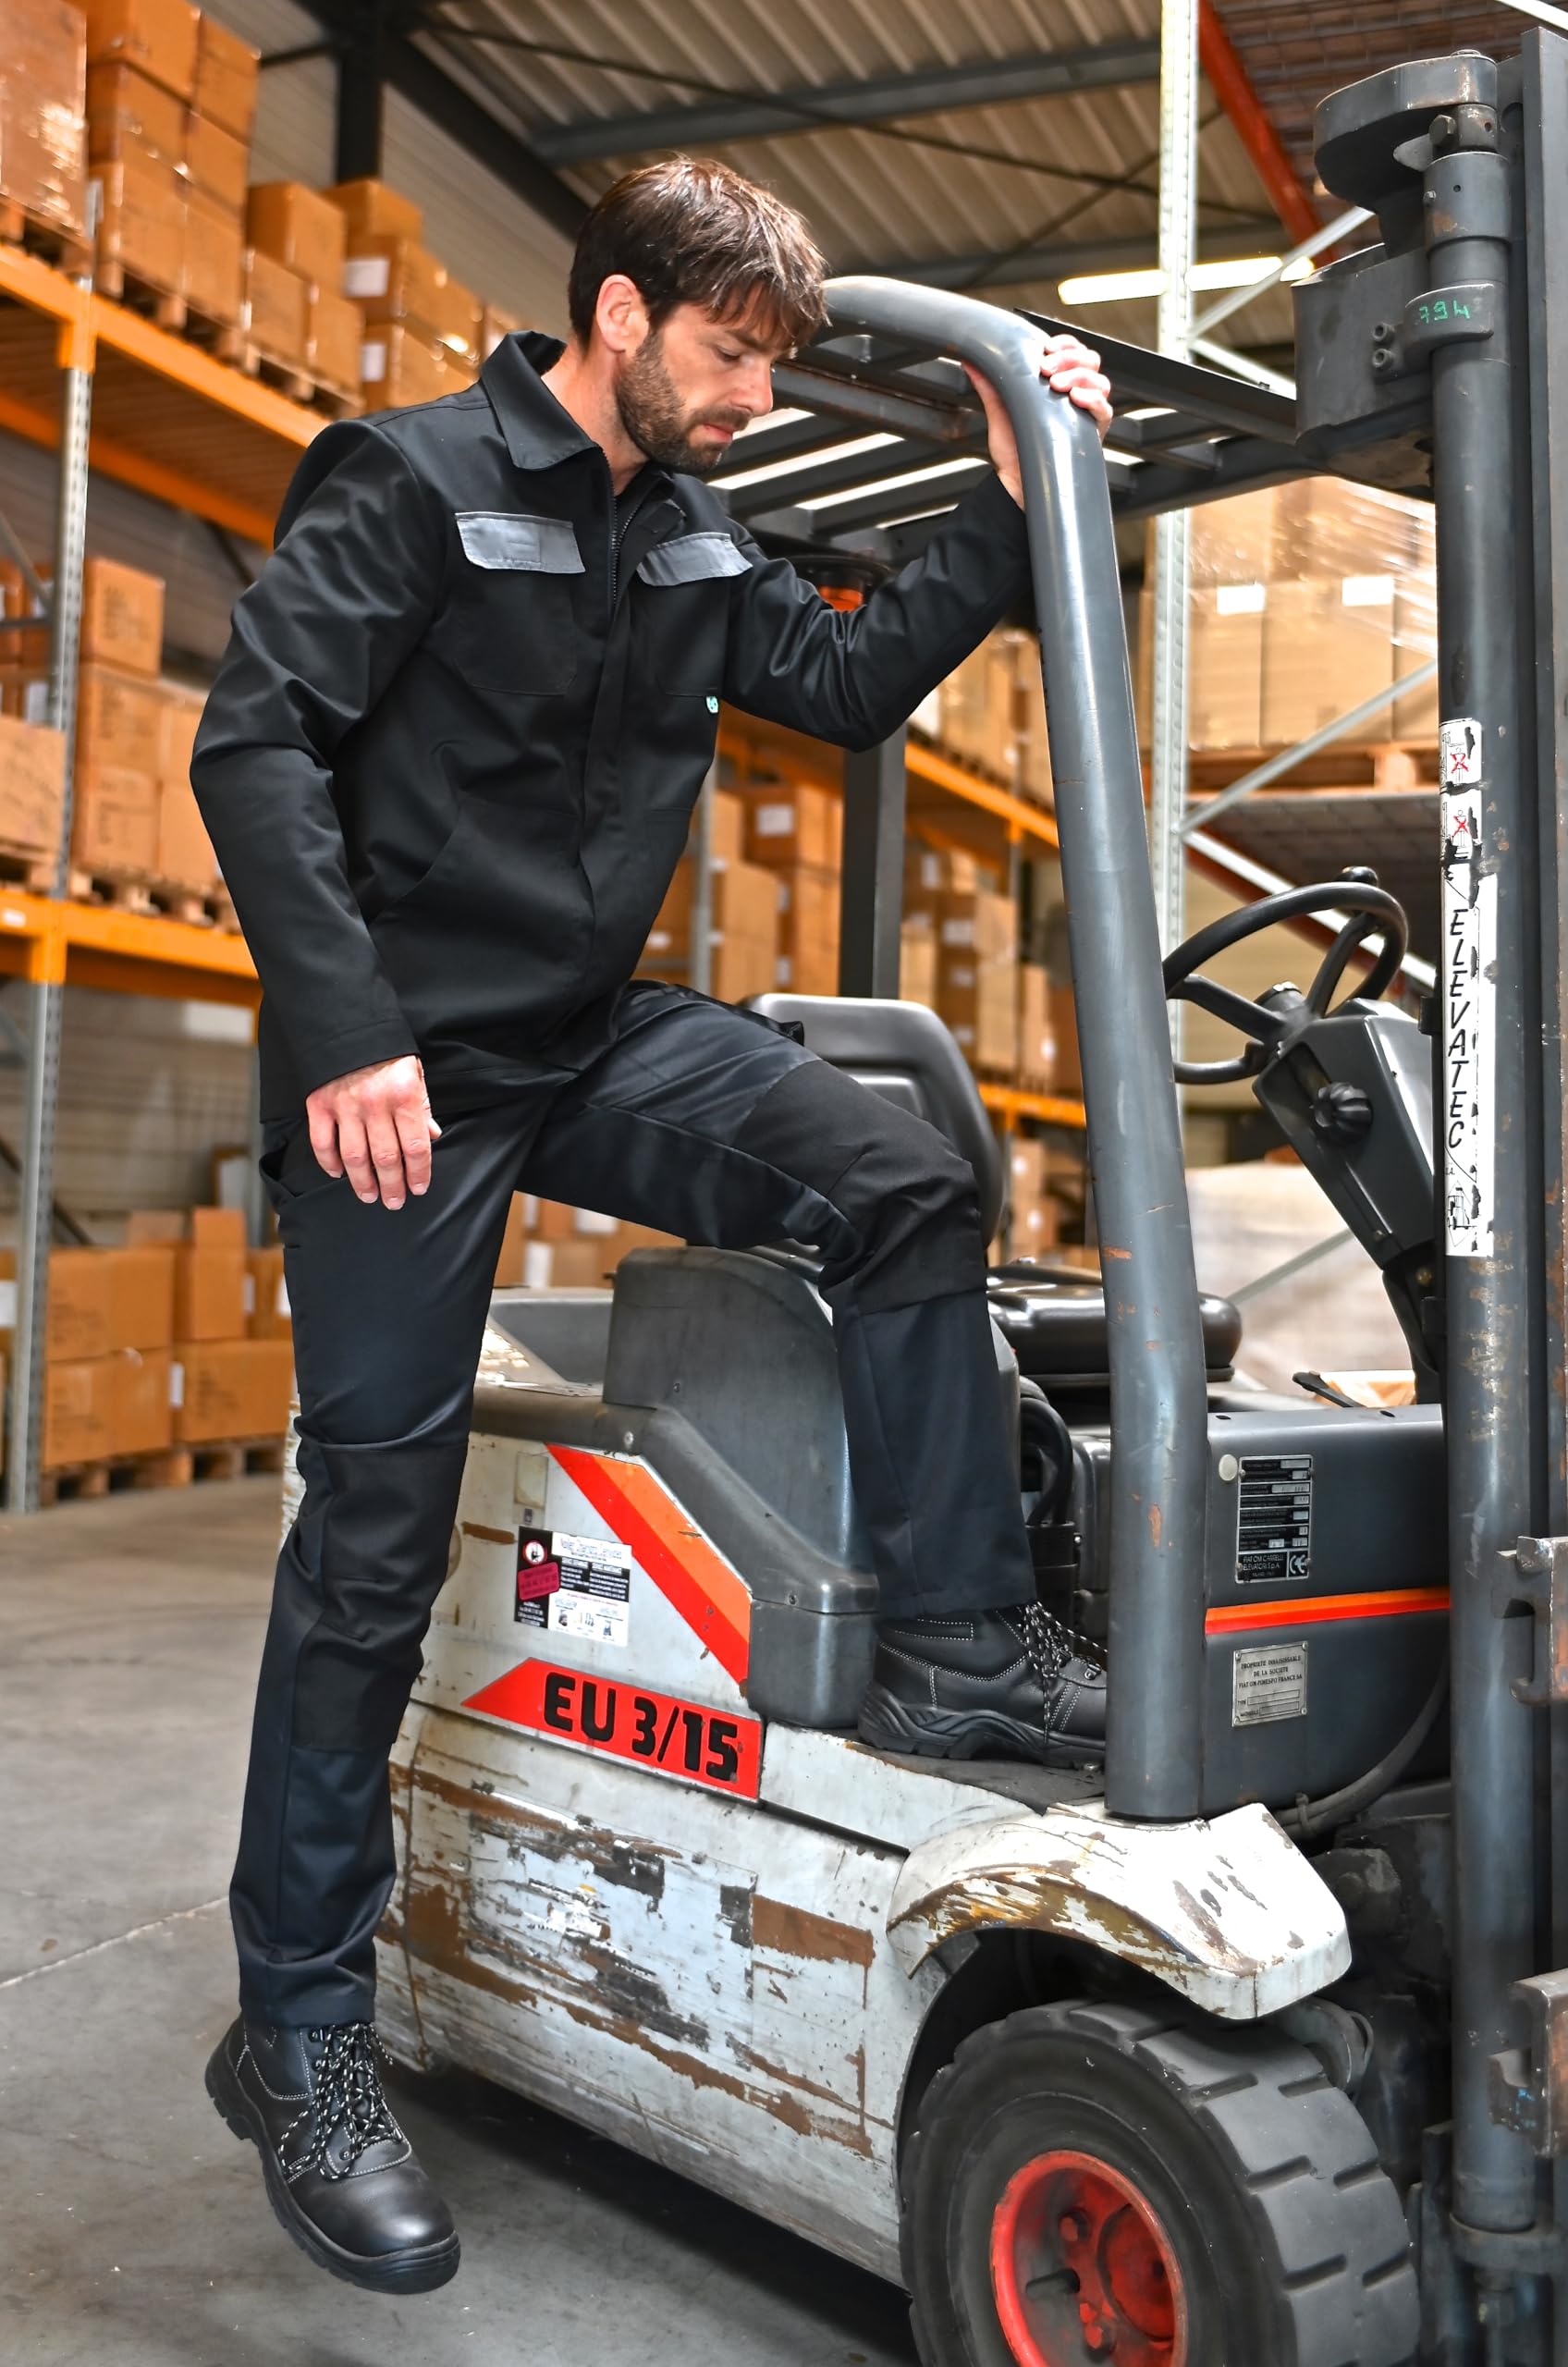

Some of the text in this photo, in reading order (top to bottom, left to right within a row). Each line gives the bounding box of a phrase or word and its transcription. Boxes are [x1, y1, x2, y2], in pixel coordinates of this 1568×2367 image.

[1419, 300, 1470, 324] 794
[1449, 908, 1470, 1148] ELEVATEC
[544, 1672, 739, 1782] EU 3/15
